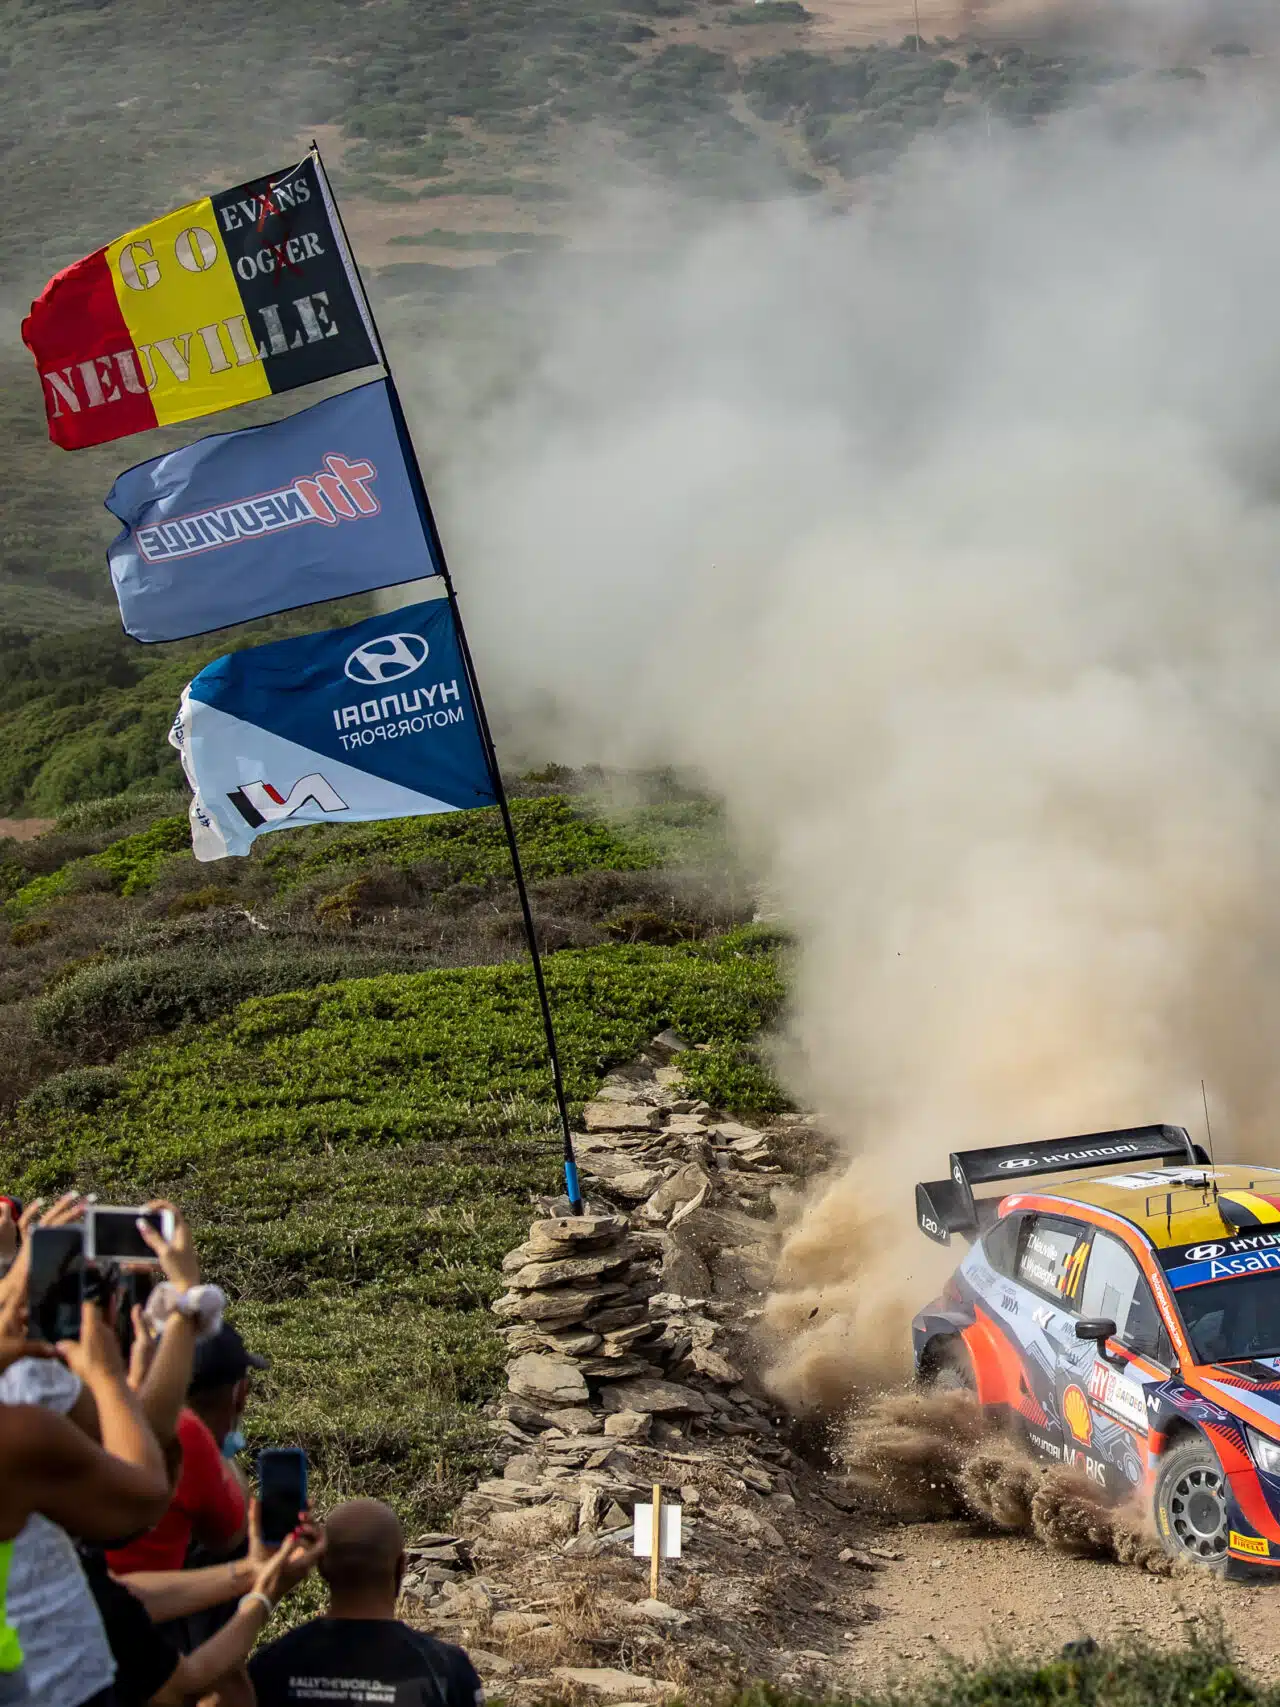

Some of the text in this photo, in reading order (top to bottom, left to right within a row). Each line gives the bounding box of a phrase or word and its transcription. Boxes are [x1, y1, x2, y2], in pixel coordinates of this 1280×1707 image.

[219, 175, 311, 232] EVANS
[236, 231, 325, 281] OGIER
[43, 290, 339, 418] NEUVILLE
[1042, 1144, 1139, 1163] HYUNDAI
[1233, 1535, 1265, 1552] PIRELLI
